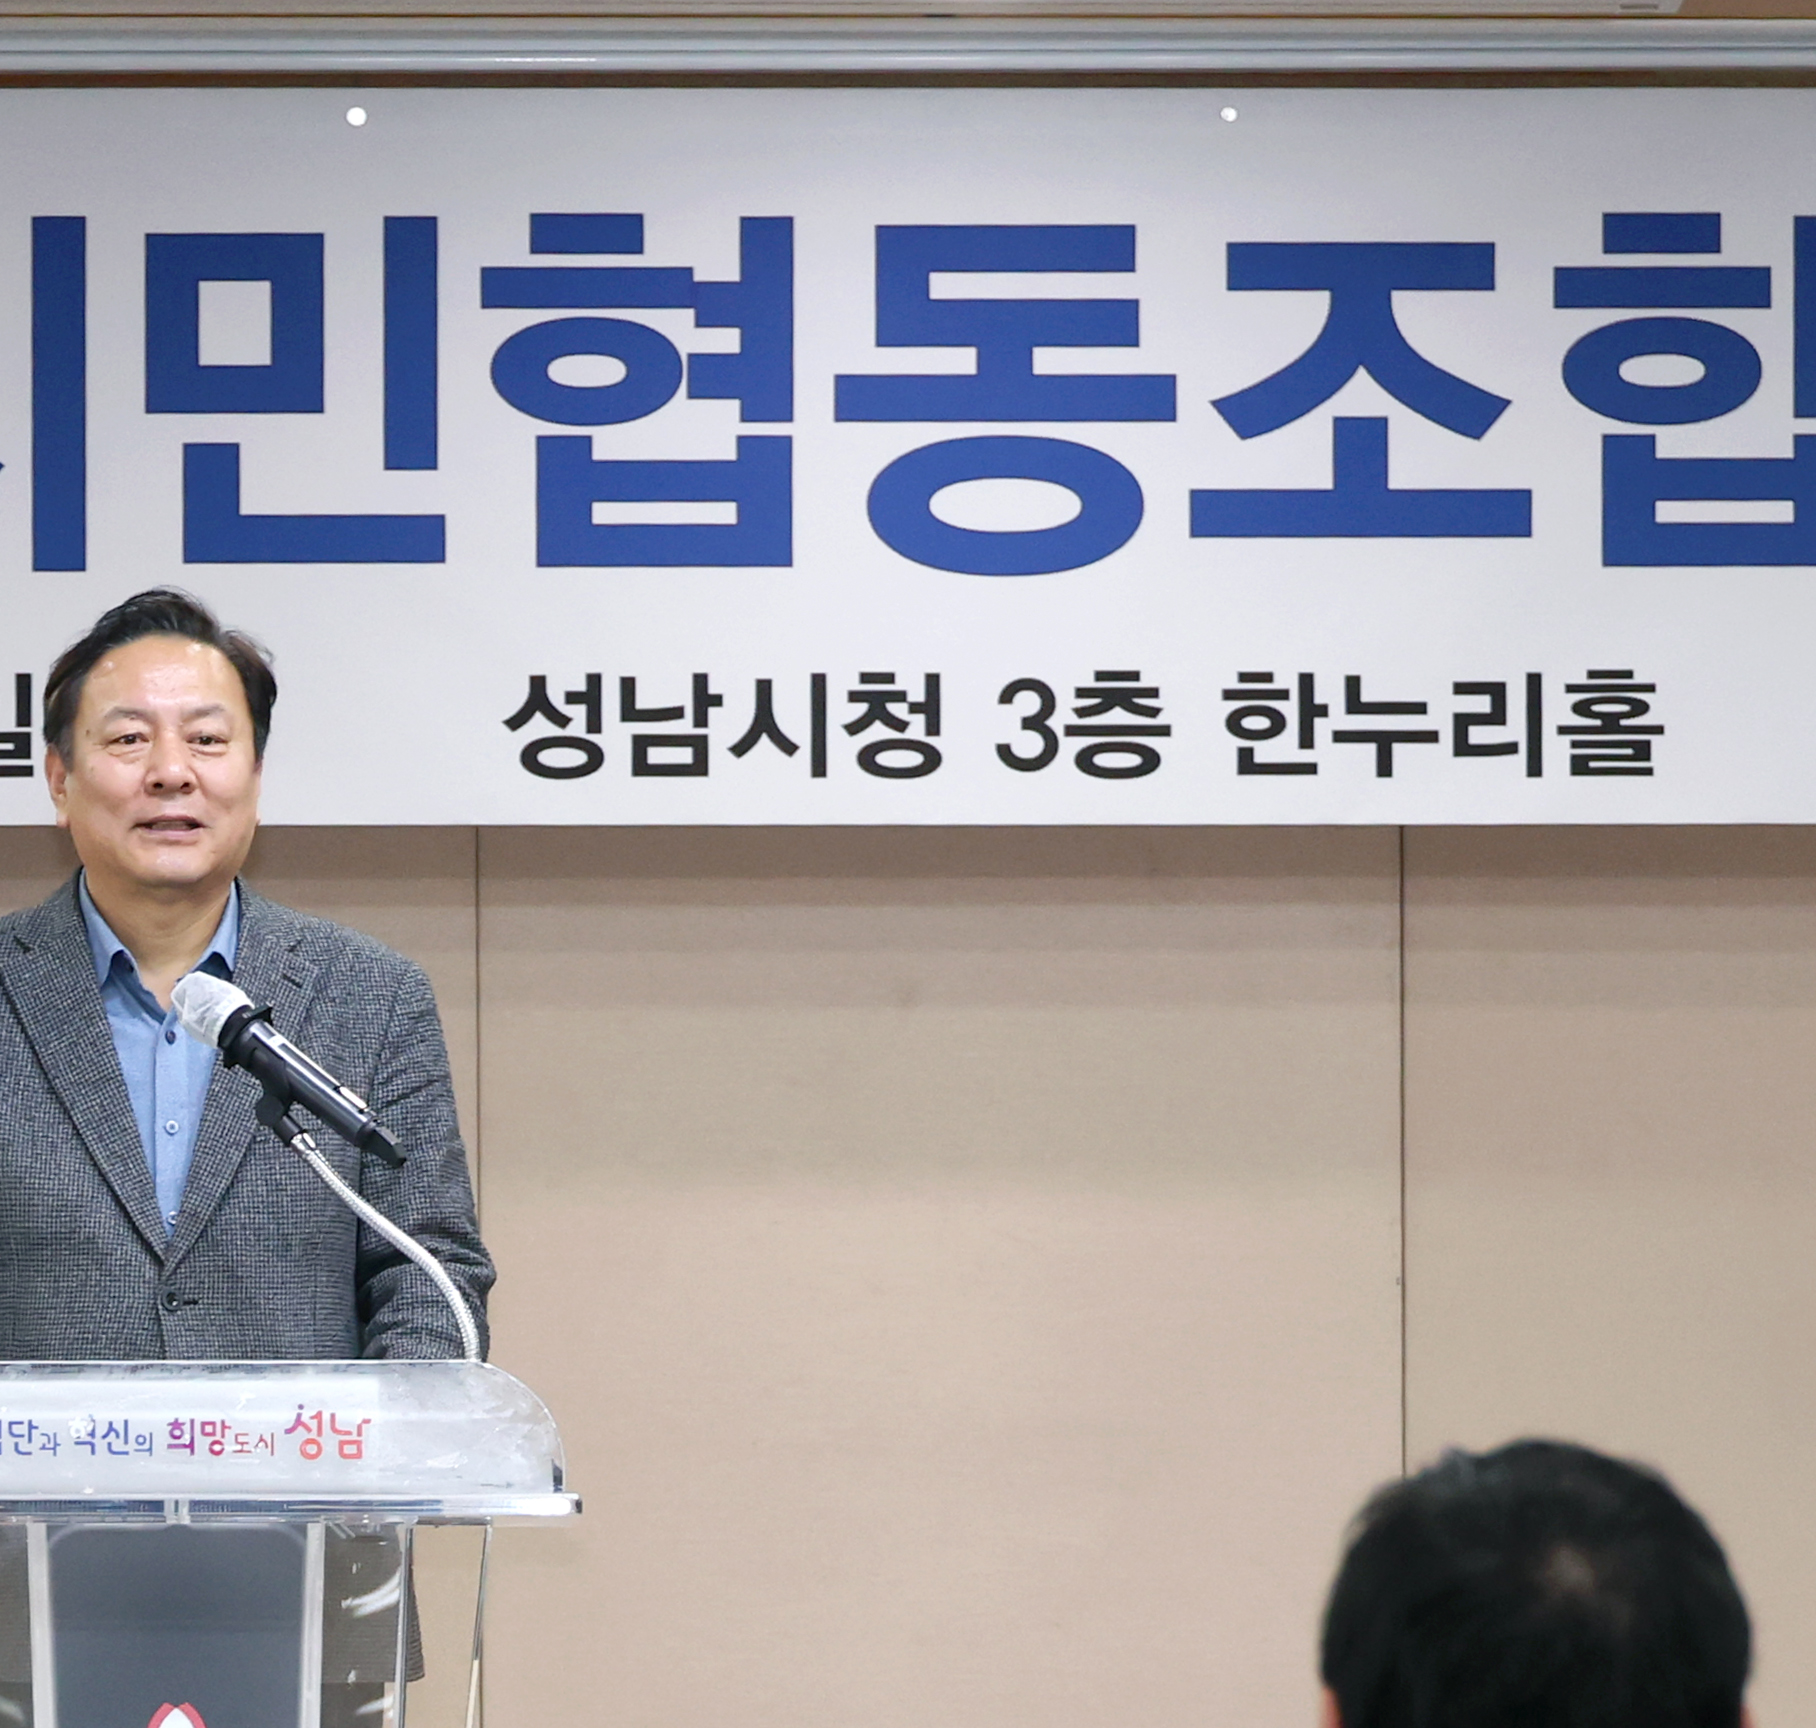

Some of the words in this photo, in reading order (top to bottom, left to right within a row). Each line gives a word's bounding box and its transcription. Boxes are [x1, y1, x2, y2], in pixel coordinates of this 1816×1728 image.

[503, 672, 943, 780] 성남시청
[995, 670, 1172, 780] 3층
[1221, 669, 1666, 778] 한누리홀
[166, 1416, 275, 1457] 희망도시
[284, 1403, 372, 1461] 성남
